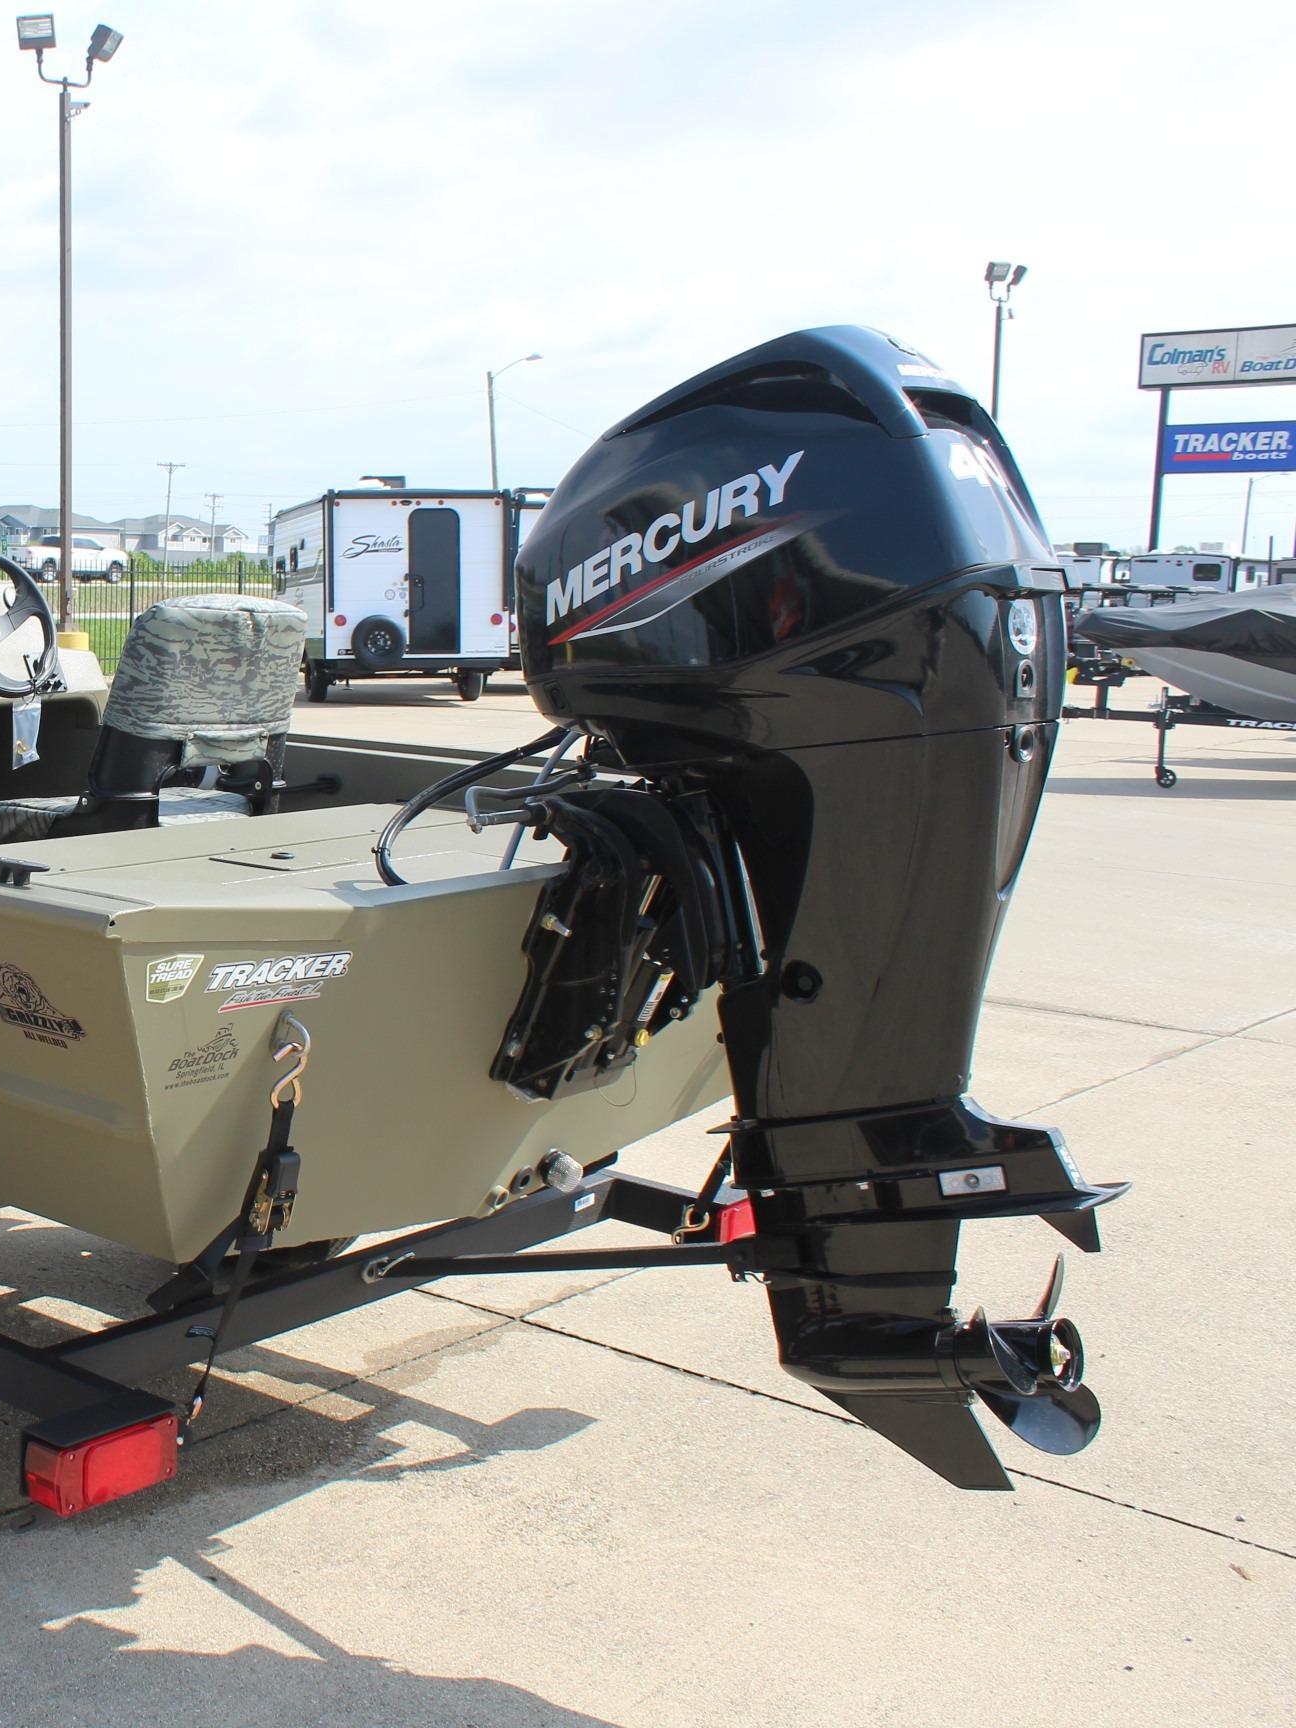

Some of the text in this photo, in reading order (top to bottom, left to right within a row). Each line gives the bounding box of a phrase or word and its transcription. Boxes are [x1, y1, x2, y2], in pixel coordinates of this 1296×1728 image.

[1147, 343, 1227, 366] Colman's
[1211, 361, 1231, 374] RV
[1239, 360, 1281, 372] Boat
[1174, 431, 1289, 453] TRACKER
[1232, 451, 1287, 461] boats
[337, 534, 402, 559] Shasta
[546, 450, 804, 626] MERCURY
[150, 968, 193, 984] TREAD
[155, 959, 193, 974] SURE
[206, 953, 350, 991] TRACKER
